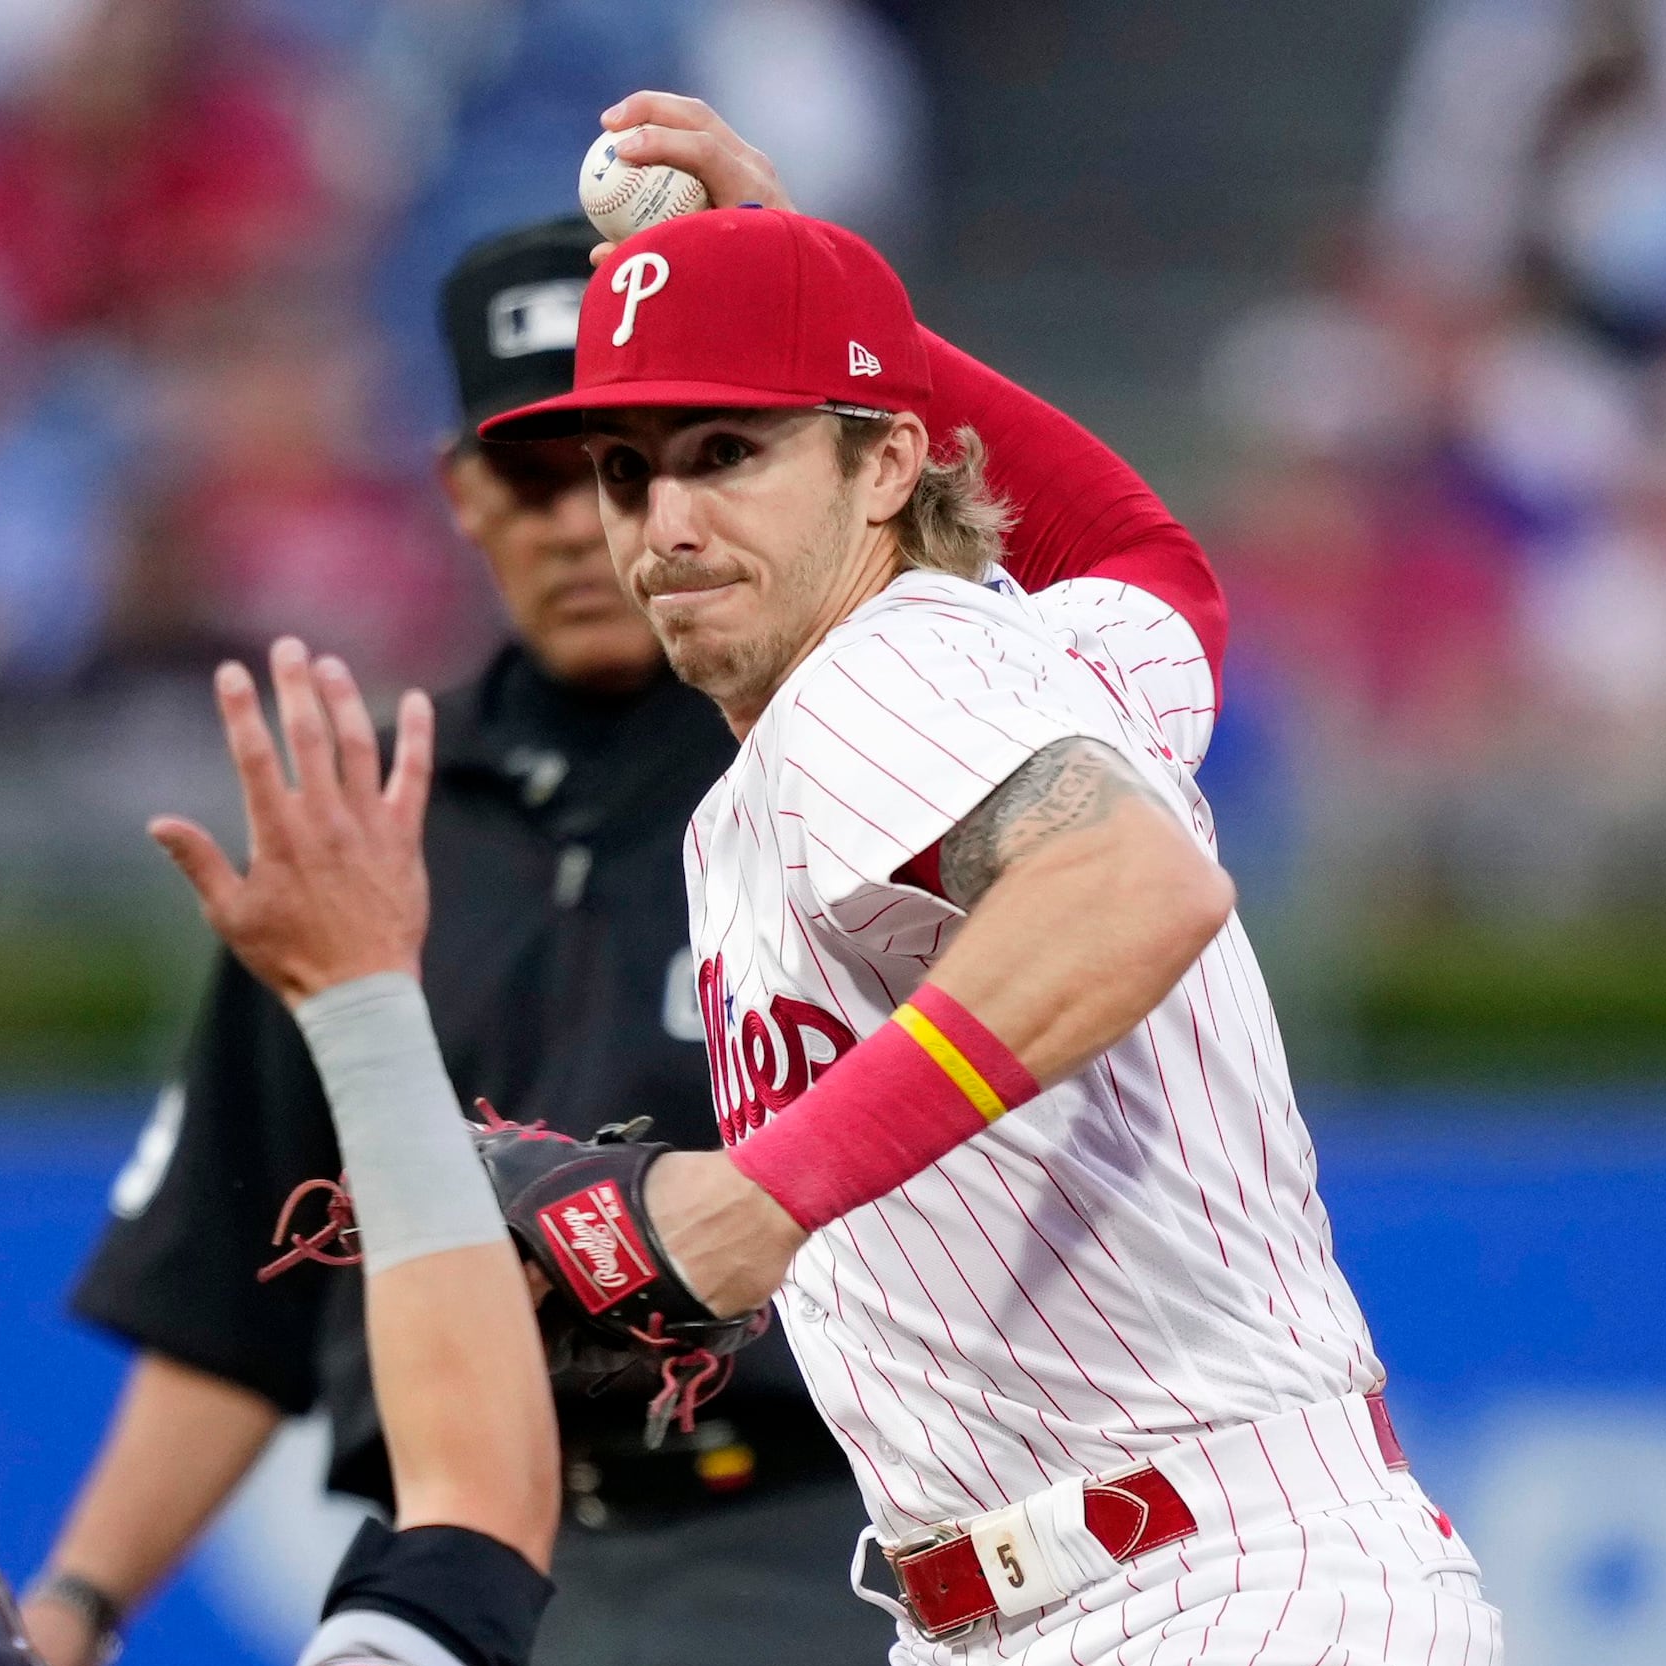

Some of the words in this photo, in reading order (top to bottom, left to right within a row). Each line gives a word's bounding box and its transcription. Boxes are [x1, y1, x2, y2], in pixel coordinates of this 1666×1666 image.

[611, 252, 670, 347] P
[560, 1206, 629, 1288] Rawlings
[996, 1543, 1025, 1588] 5
